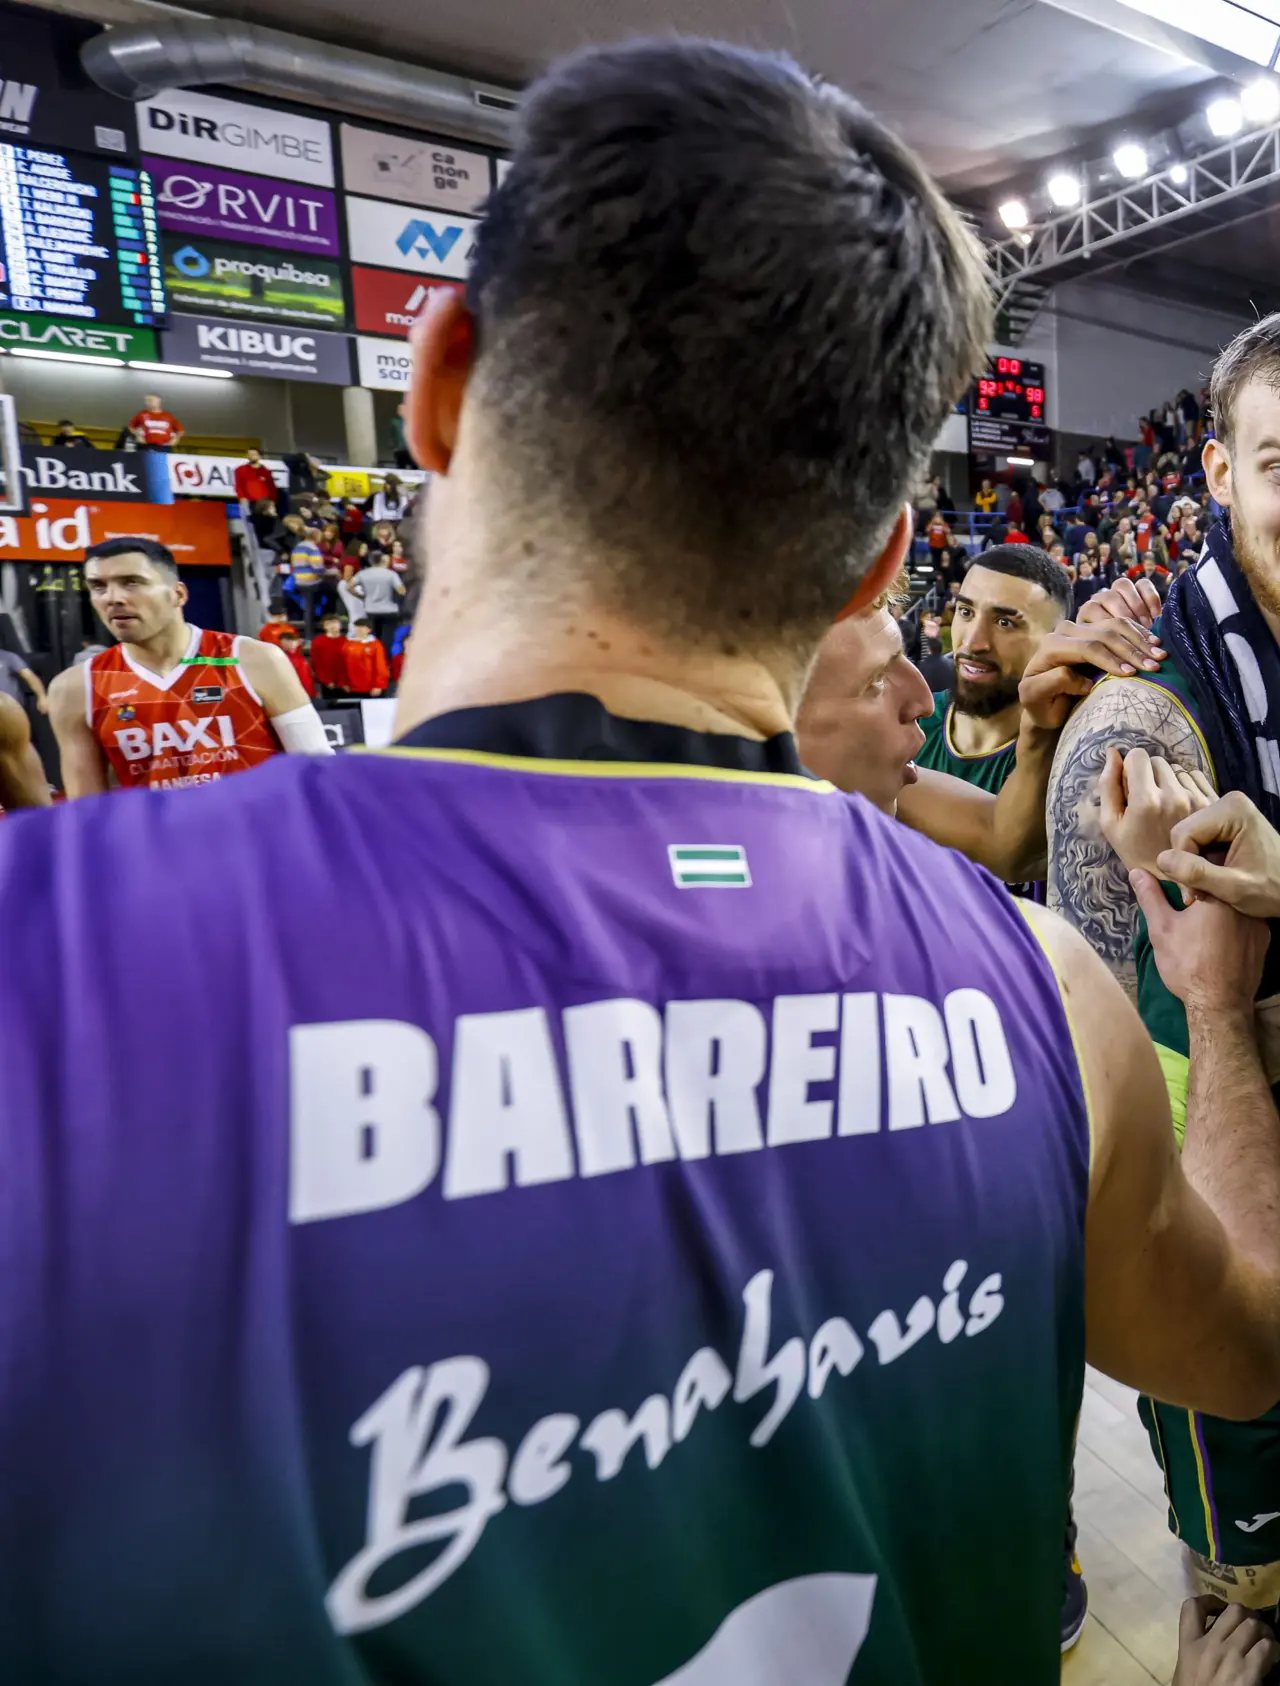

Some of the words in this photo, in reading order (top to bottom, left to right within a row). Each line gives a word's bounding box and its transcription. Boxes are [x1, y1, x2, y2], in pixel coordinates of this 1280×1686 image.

[147, 106, 323, 164] DiRGIMBE
[431, 151, 455, 166] ca
[432, 163, 470, 181] non
[433, 175, 459, 191] ge
[197, 324, 317, 361] KIBUC
[114, 715, 236, 761] BAXI
[289, 987, 1017, 1224] BARREIRO
